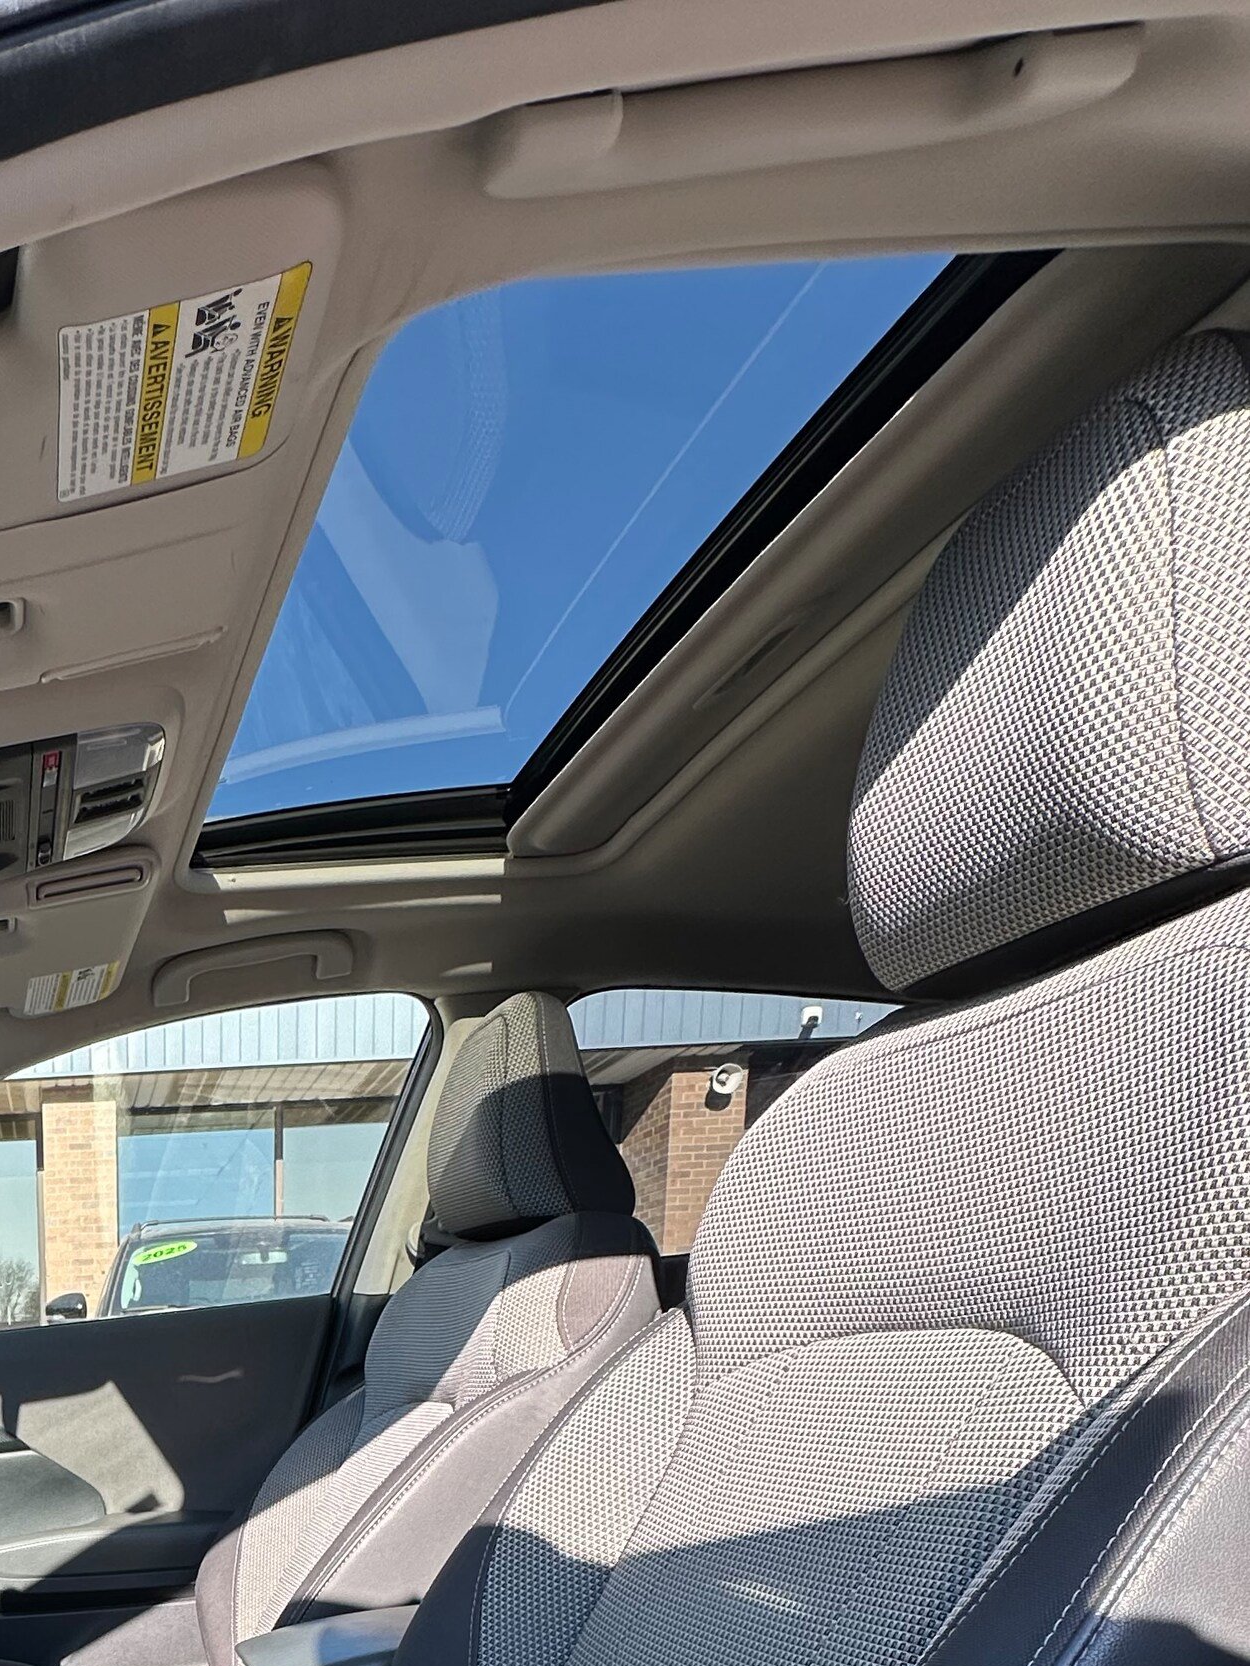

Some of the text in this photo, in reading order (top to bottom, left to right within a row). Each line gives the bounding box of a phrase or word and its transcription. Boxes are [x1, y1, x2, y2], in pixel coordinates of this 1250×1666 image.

[136, 340, 170, 472] AVERTISSEMENT
[226, 301, 270, 449] EVEN WITH ADVANCED AIR BAGS
[251, 327, 294, 418] WARNING
[141, 1243, 187, 1261] 2025
